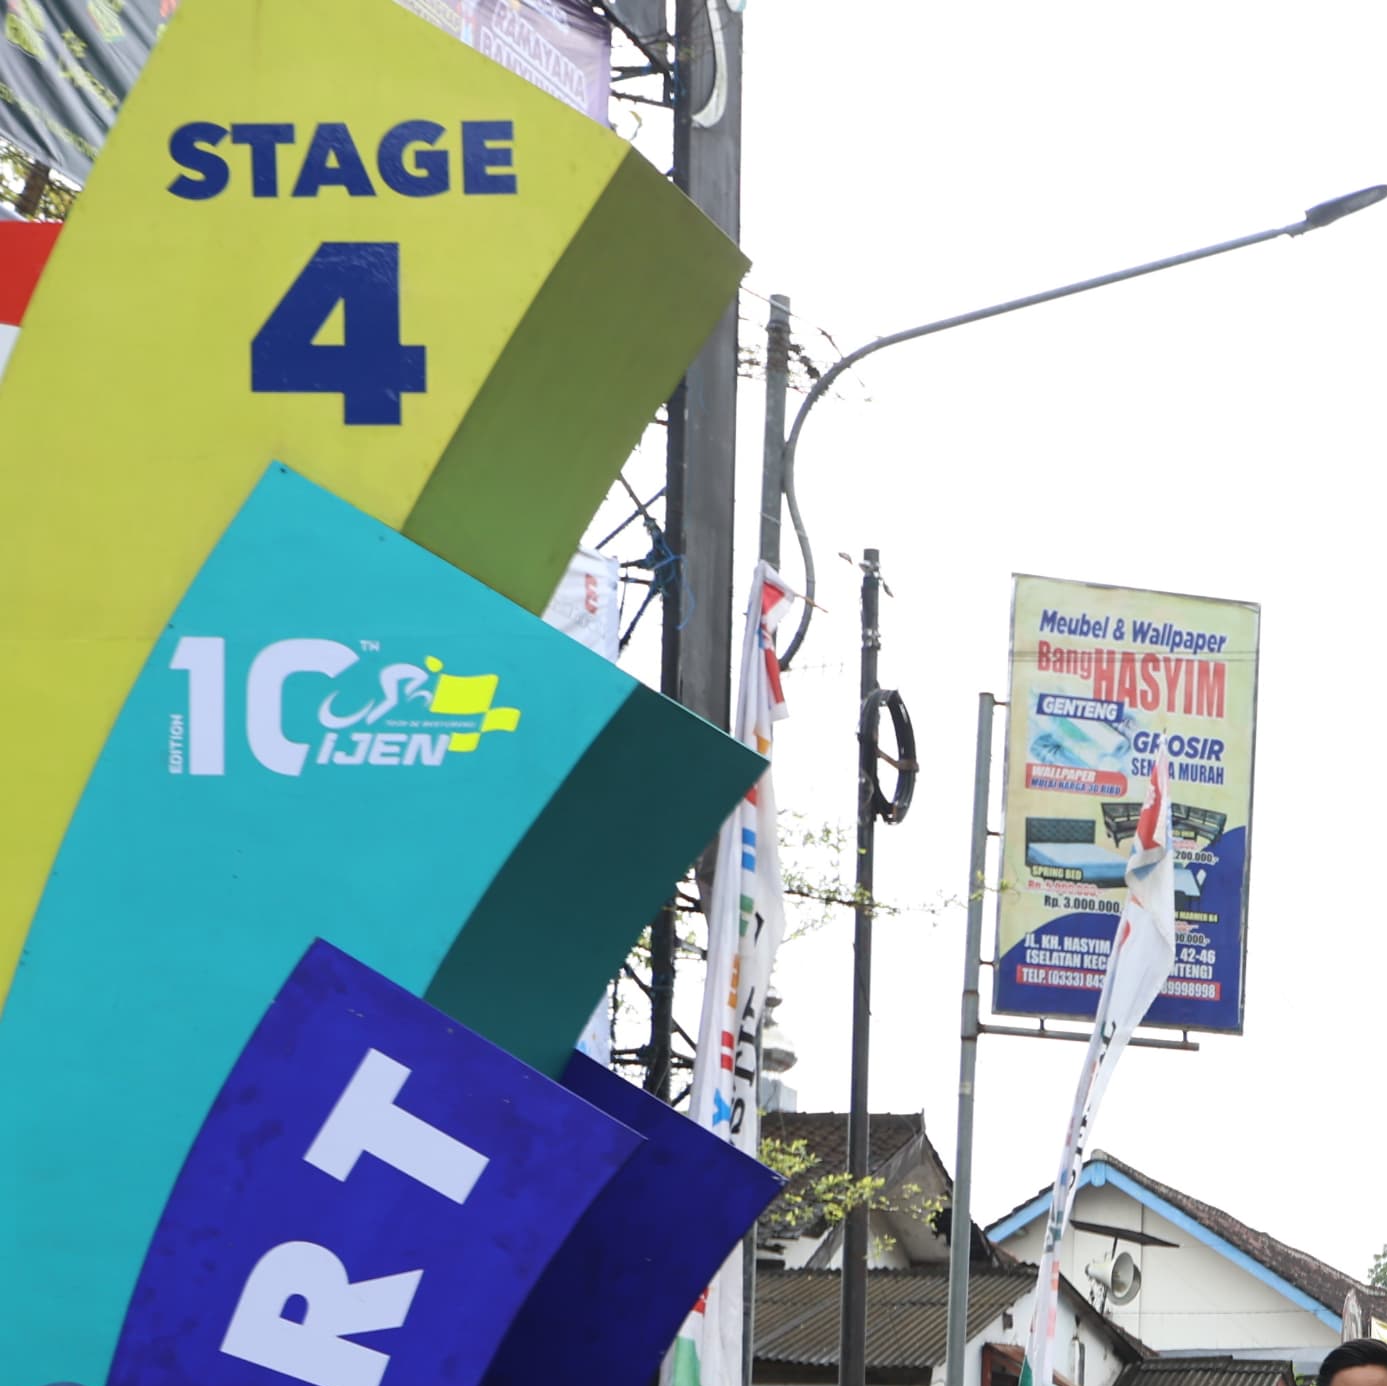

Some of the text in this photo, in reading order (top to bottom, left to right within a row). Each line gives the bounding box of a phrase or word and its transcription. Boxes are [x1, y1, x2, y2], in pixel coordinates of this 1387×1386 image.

[167, 119, 518, 201] STAGE
[250, 241, 427, 426] 4
[1039, 608, 1227, 655] Meubel & Wallpaper
[360, 639, 380, 652] TH
[1037, 640, 1226, 719] Bang HASYIM
[1042, 696, 1119, 721] GENTENG
[169, 713, 183, 775] EDITION
[1178, 761, 1225, 785] MURAH
[1044, 895, 1061, 909] Rp.
[1024, 933, 1111, 954] JL. KH. HASYIM
[1026, 949, 1082, 968] (SELATAN
[1180, 948, 1216, 965] 42-46
[1022, 967, 1047, 983] TELP.
[1048, 969, 1085, 987] (0333)
